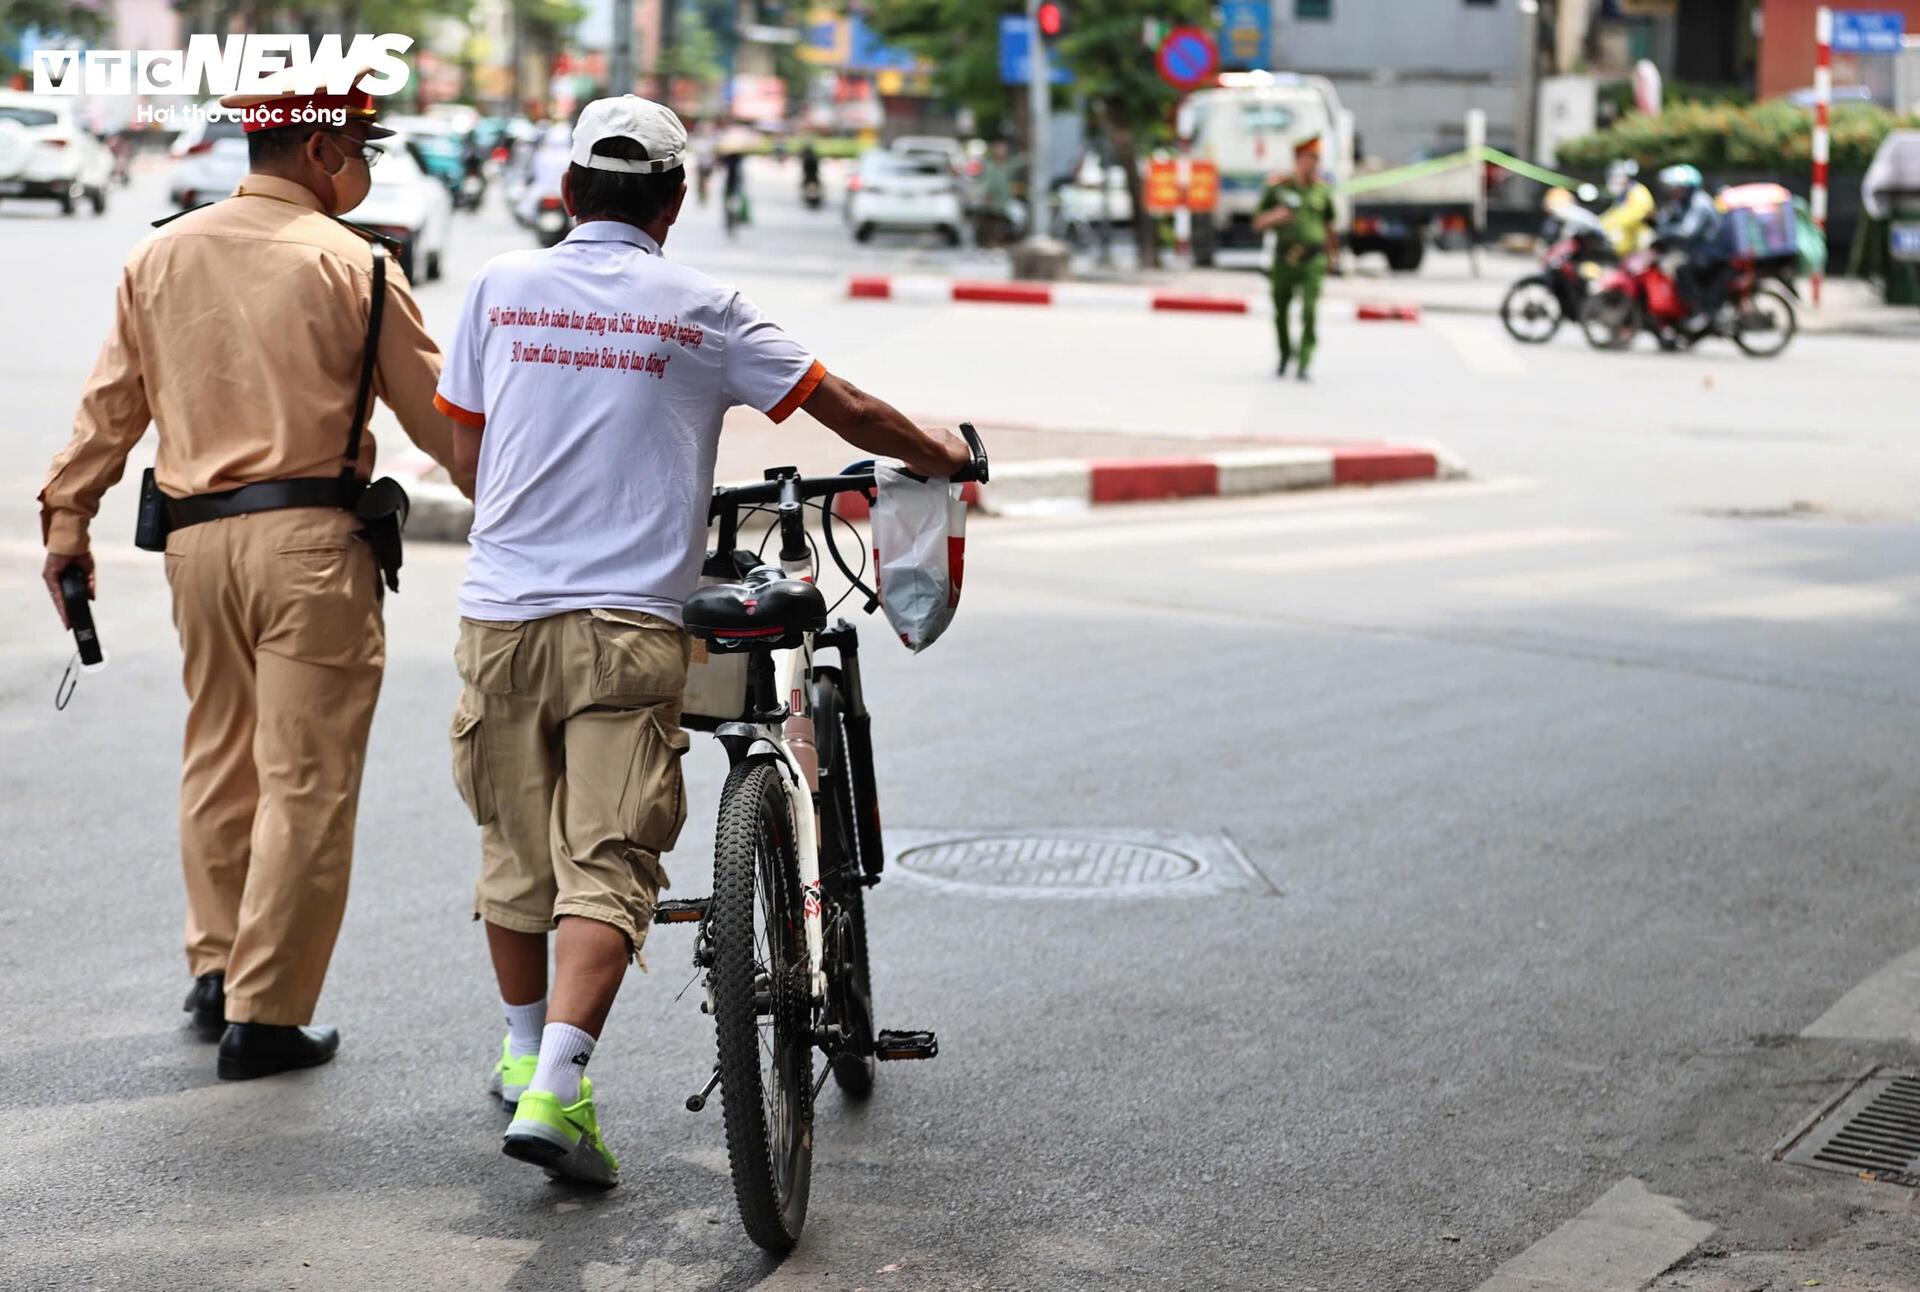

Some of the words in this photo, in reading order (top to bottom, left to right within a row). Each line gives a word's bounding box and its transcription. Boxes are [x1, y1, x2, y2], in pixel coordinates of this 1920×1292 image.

[501, 306, 517, 326] năm
[517, 306, 537, 326] khoa
[538, 306, 550, 327] An
[551, 308, 570, 328] toàn
[571, 310, 585, 330] lao
[585, 311, 607, 337] động
[608, 312, 618, 333] và
[619, 313, 636, 333] Sức
[658, 315, 678, 342] nghề
[678, 323, 703, 350] nghiệp
[511, 341, 522, 363] 30
[522, 343, 540, 363] năm
[541, 342, 557, 364] đào
[558, 347, 573, 370] tạo
[573, 346, 600, 371] ngành
[601, 347, 617, 370] Bảo
[618, 349, 630, 374] hộ
[631, 350, 645, 371] lao
